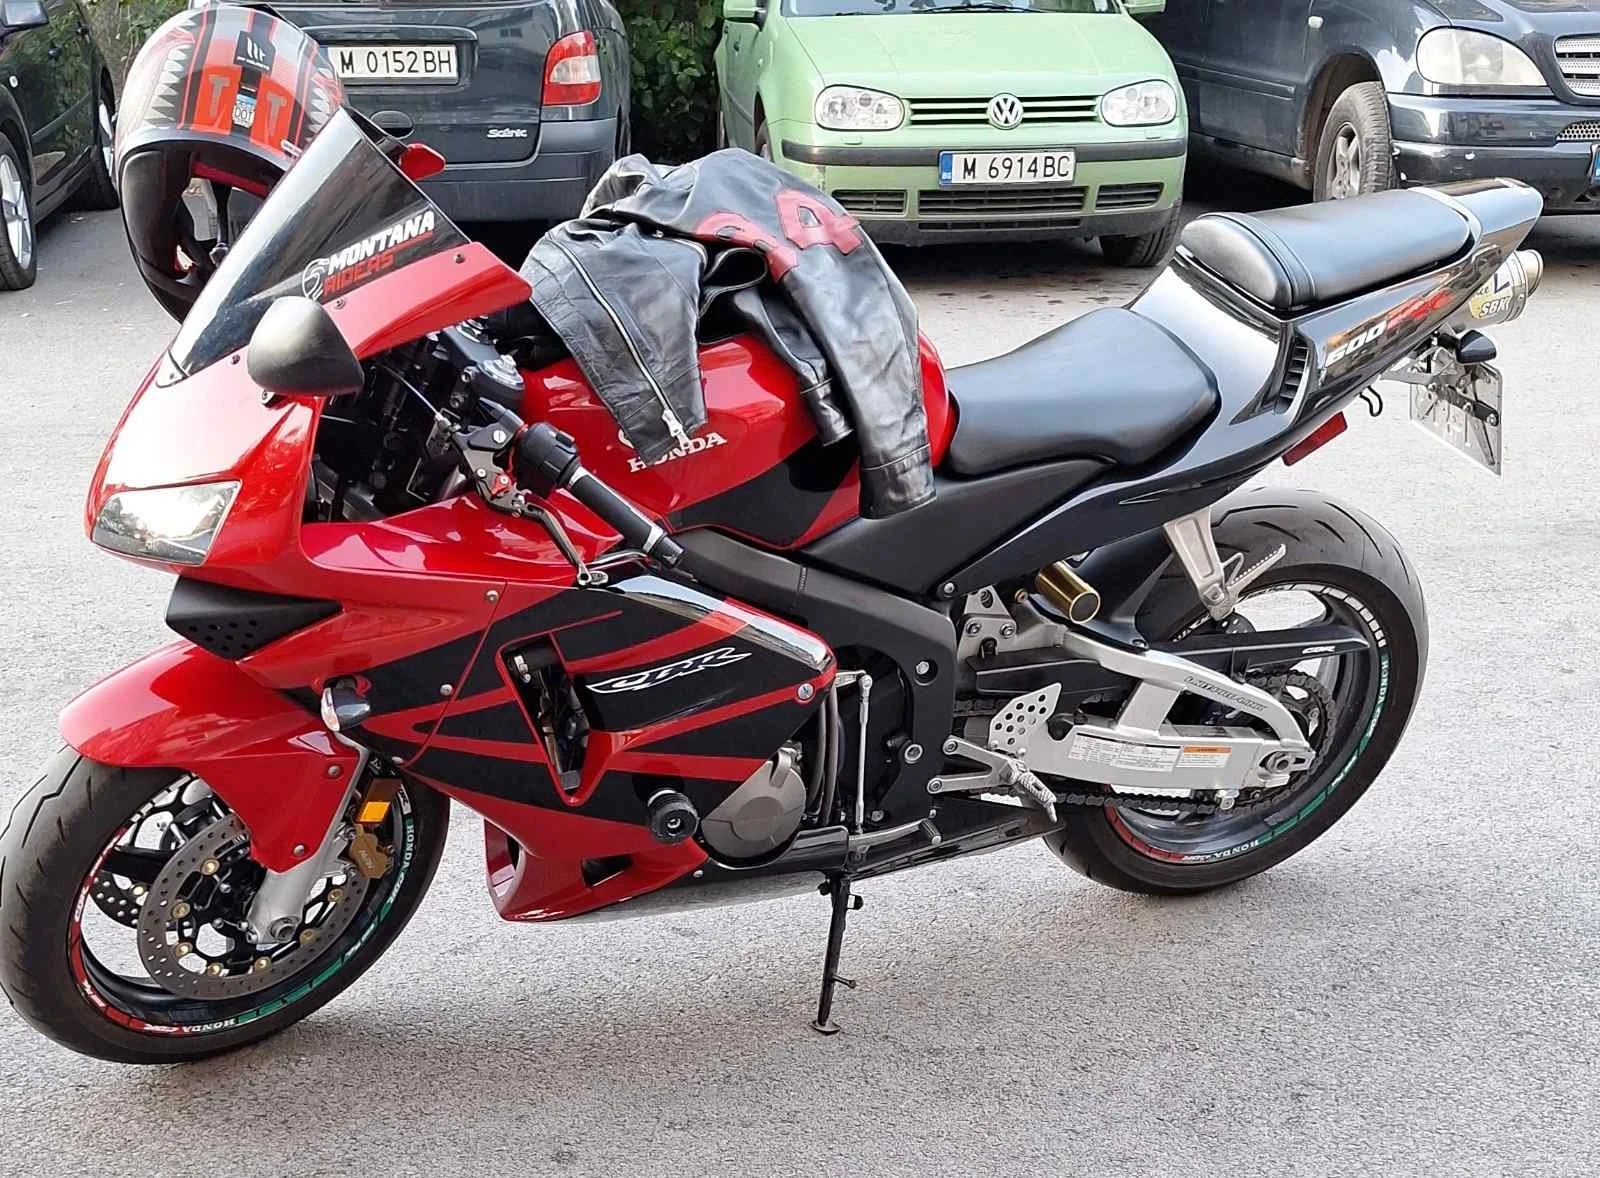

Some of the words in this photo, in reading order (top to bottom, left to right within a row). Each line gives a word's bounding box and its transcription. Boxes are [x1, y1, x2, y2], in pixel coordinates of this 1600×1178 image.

[340, 51, 354, 74] M
[962, 157, 977, 180] M
[327, 210, 436, 275] MONTANA
[1379, 659, 1390, 704] HONDA
[402, 824, 415, 869] HONDA
[1213, 839, 1260, 859] HONDA
[182, 1018, 236, 1033] HONDA
